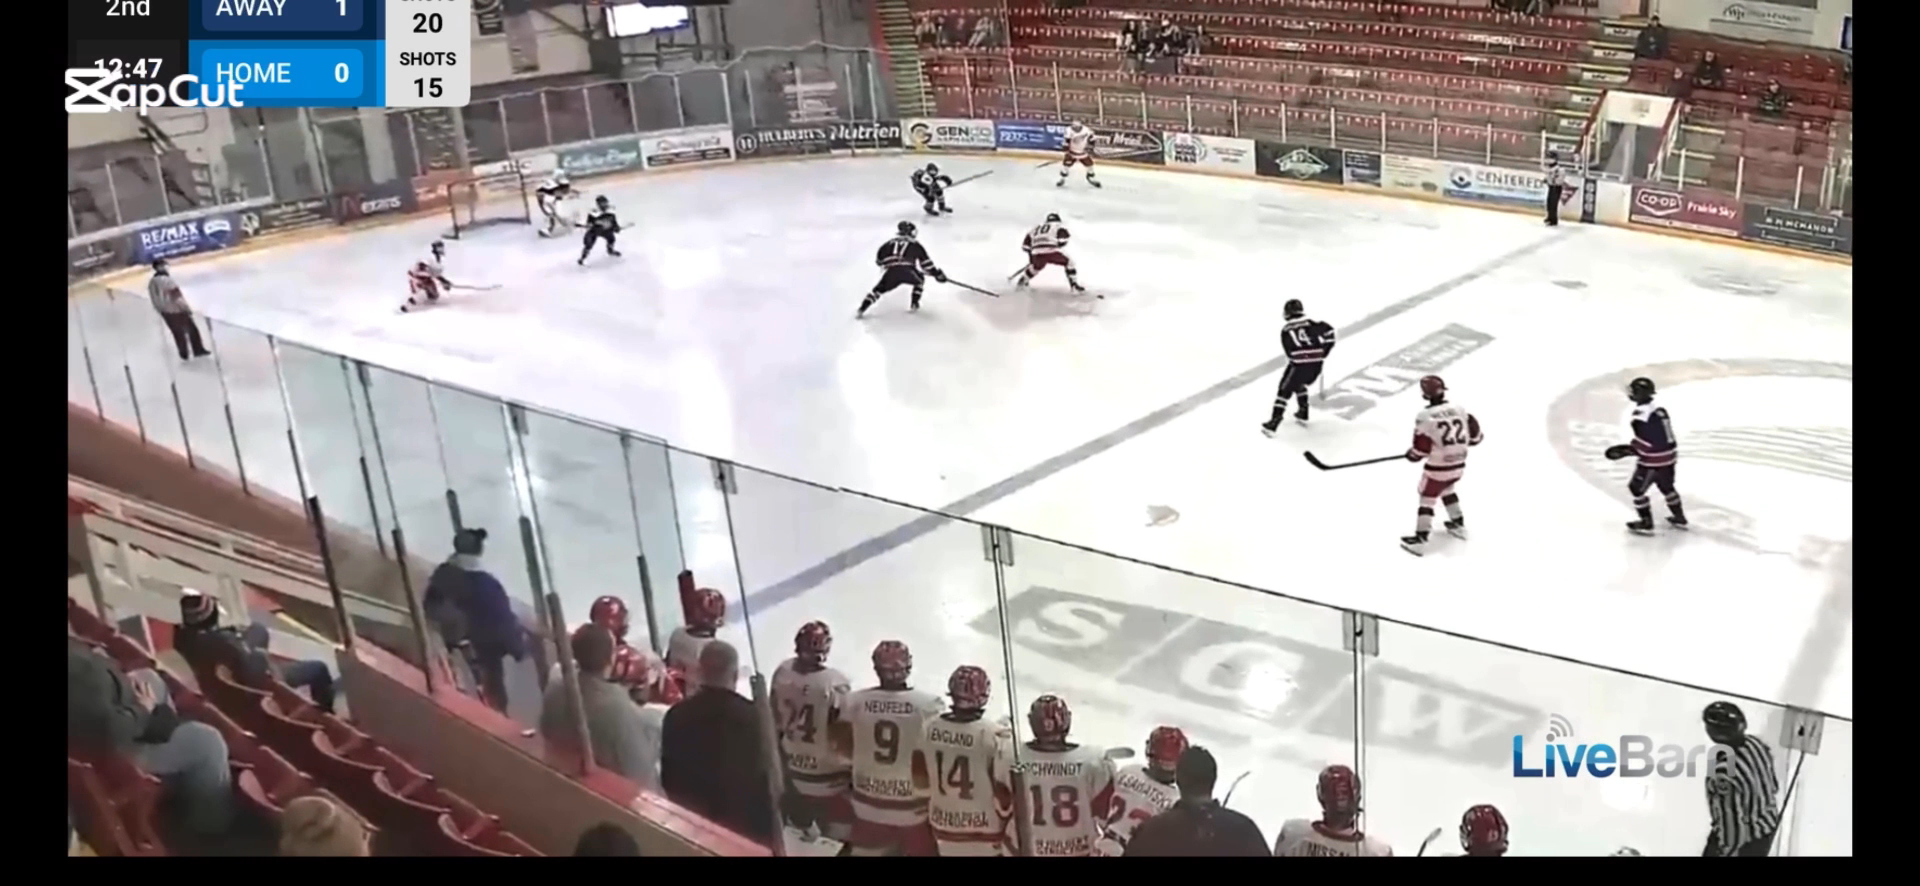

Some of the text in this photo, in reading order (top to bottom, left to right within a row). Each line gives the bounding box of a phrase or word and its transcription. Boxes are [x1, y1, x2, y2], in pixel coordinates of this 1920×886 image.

[829, 122, 900, 141] Nutrien
[936, 125, 993, 138] GENCO
[1475, 170, 1544, 188] CENTERED
[1640, 193, 1676, 208] CO-OP
[1686, 201, 1738, 220] Prairie Sky
[140, 222, 199, 246] RE/MAX
[890, 240, 909, 255] 17
[1289, 327, 1312, 348] 14
[1436, 418, 1467, 446] 22
[864, 700, 914, 715] NEUFELD
[873, 719, 900, 765] 9
[930, 727, 975, 748] ENGLAND
[935, 750, 975, 800] 14
[1030, 784, 1080, 828] 18
